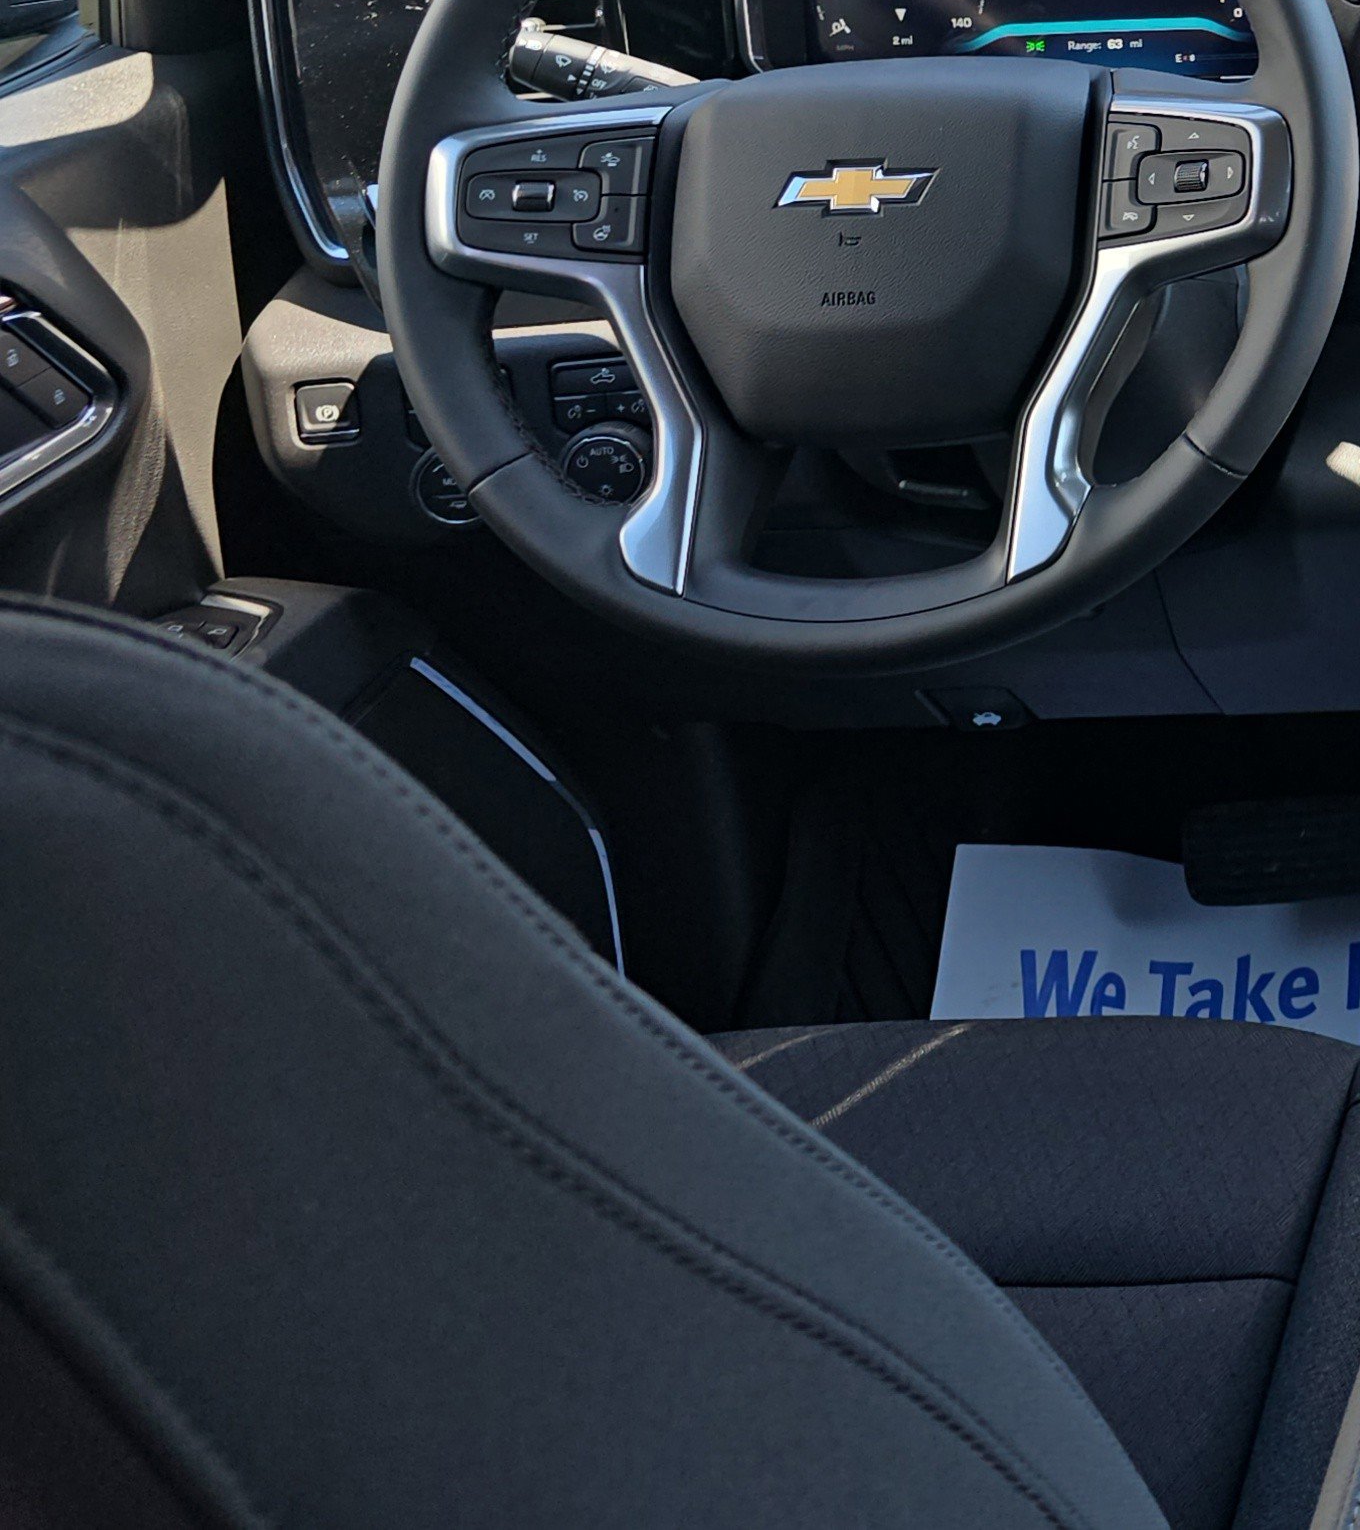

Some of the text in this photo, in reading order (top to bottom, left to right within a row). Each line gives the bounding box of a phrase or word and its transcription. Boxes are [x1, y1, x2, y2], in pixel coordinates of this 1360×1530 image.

[951, 17, 972, 28] 140
[892, 35, 913, 45] 2 mi
[1068, 38, 1143, 51] Range: 63 mi
[531, 154, 547, 162] RES
[523, 233, 538, 241] SET
[821, 291, 876, 307] AIRBAG
[590, 446, 614, 456] AUTO
[1020, 949, 1126, 1018] We
[1149, 954, 1320, 1023] Take
